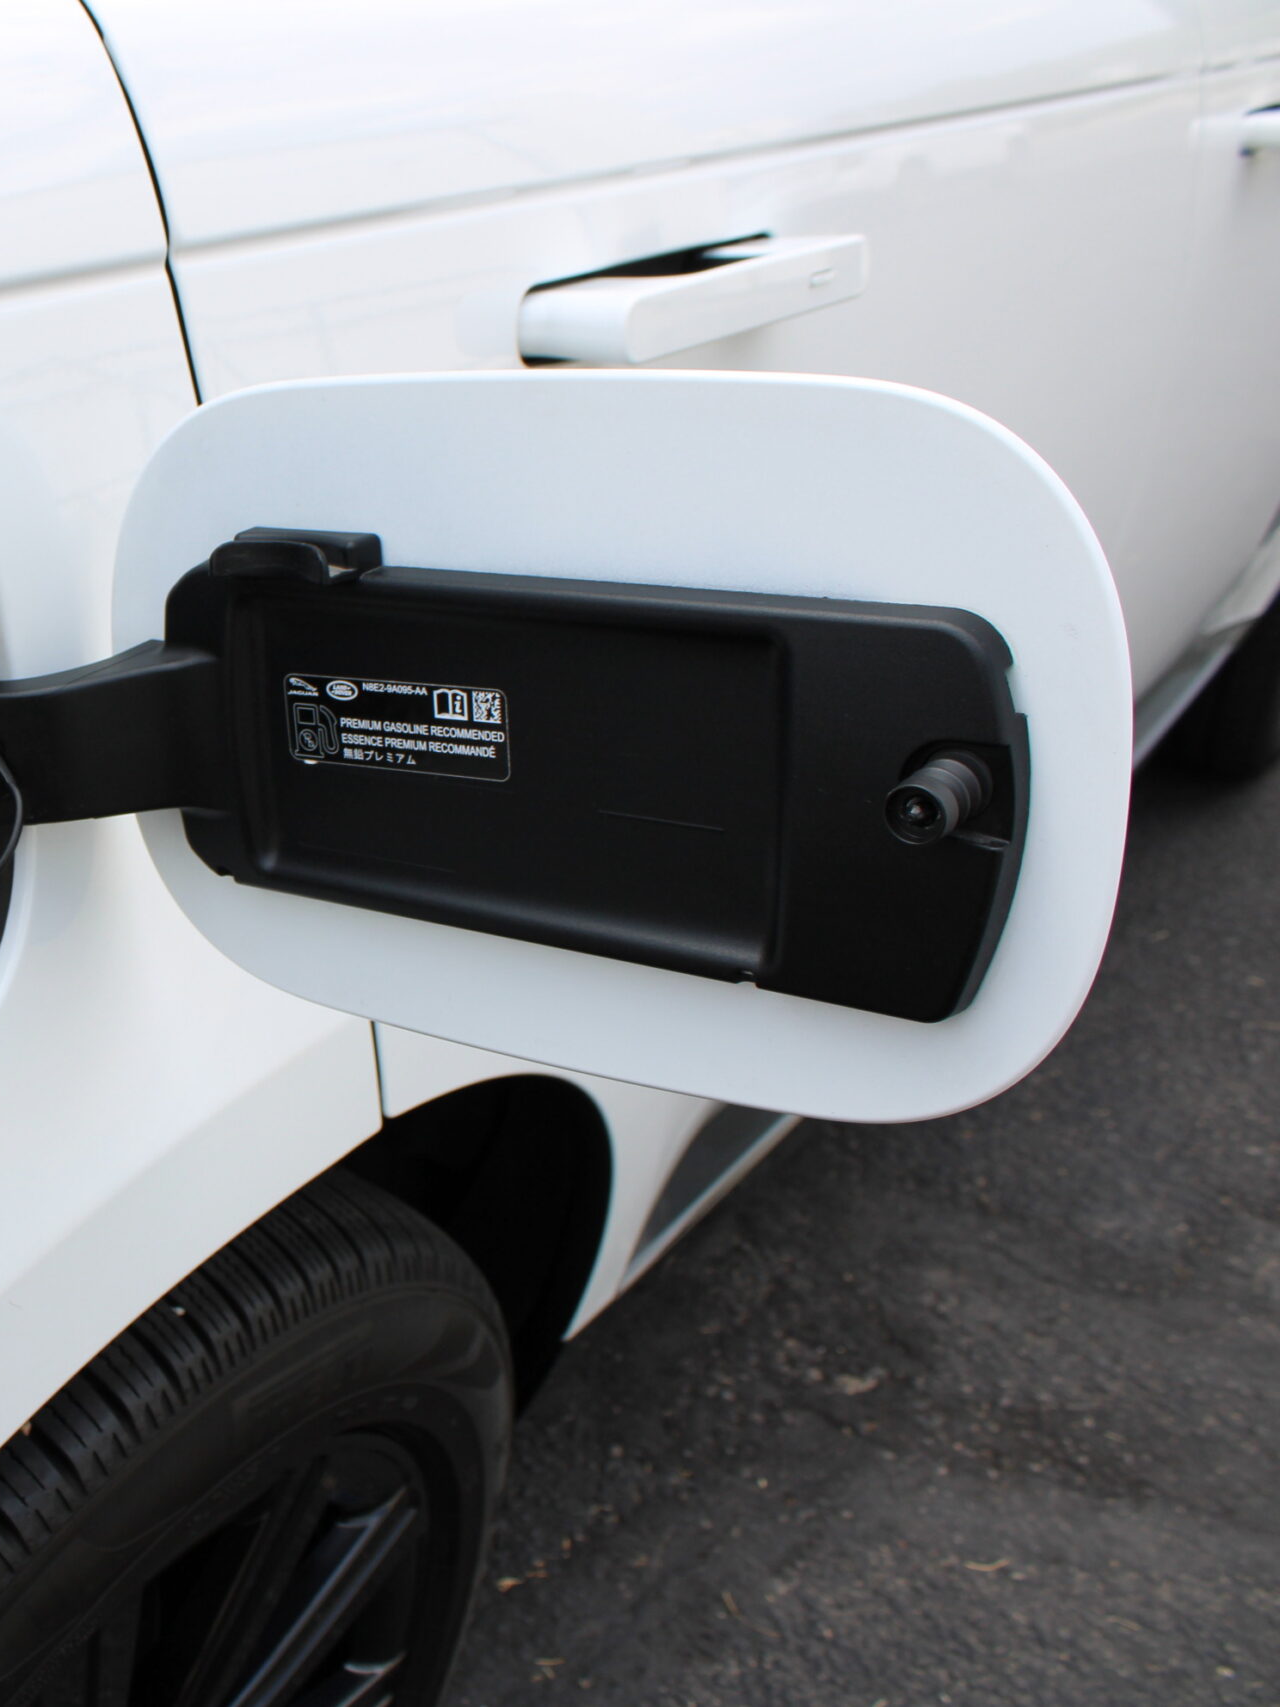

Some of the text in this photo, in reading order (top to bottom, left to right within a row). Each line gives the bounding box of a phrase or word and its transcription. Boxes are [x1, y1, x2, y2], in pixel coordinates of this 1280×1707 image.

[340, 717, 505, 742] PREMIUM GASOLINE RECOMMENDED
[341, 733, 496, 758] ESSENCE PREMIUM RECOMMANDÉ
